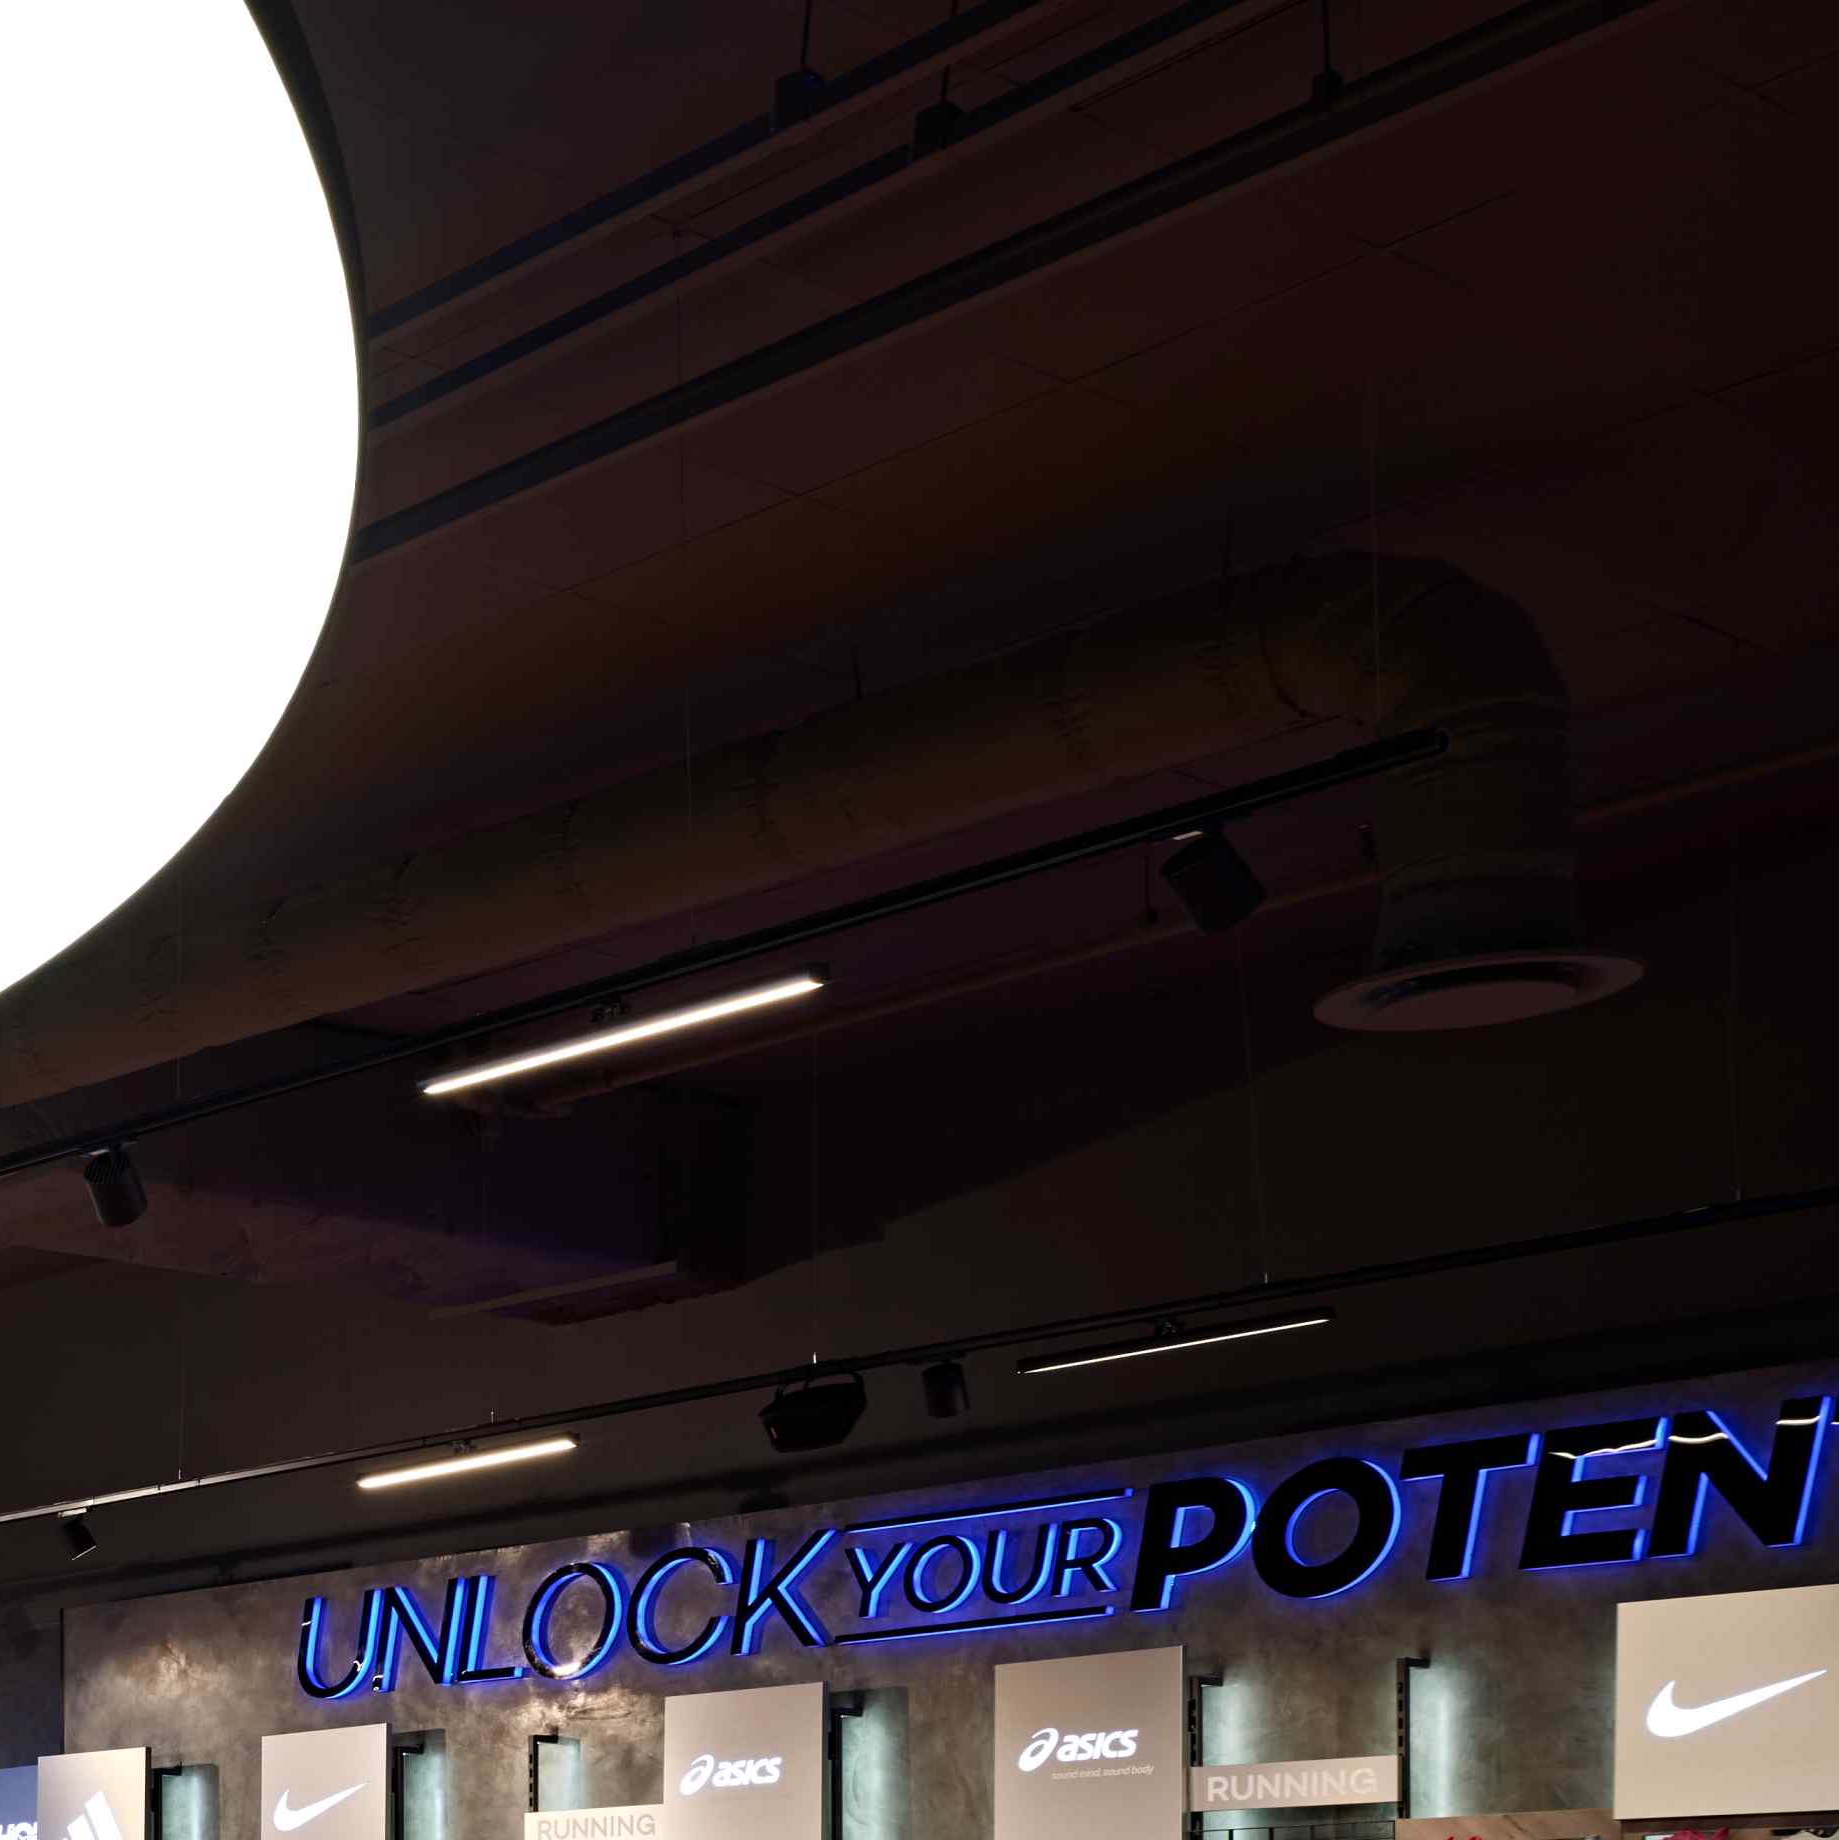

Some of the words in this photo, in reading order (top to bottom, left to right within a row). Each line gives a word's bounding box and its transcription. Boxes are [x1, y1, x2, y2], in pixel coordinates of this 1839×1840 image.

[297, 1527, 842, 1700] UNLOCK
[846, 1516, 1123, 1620] YOUR
[1130, 1394, 1839, 1613] POTEN
[1056, 1729, 1139, 1761] asics
[712, 1754, 781, 1787] asics
[1207, 1765, 1379, 1802] RUNNING
